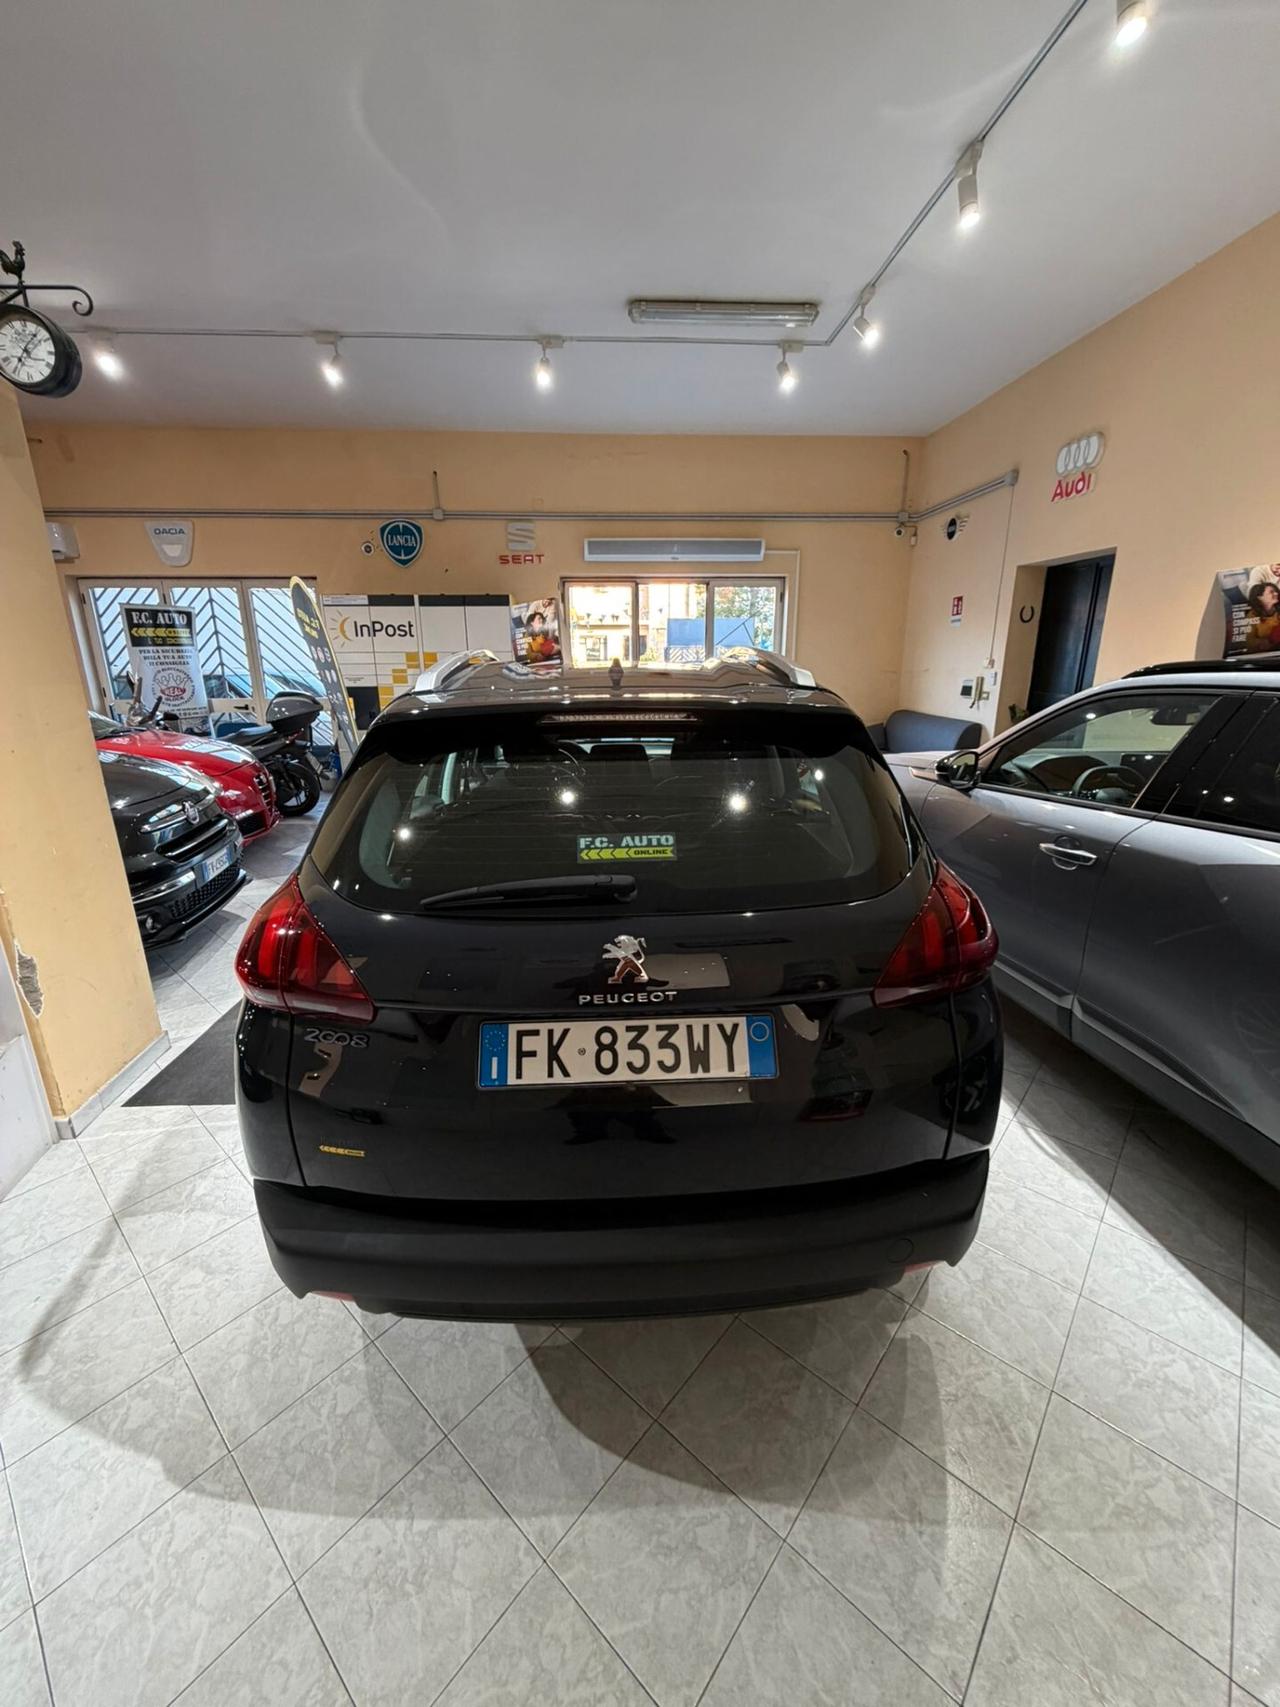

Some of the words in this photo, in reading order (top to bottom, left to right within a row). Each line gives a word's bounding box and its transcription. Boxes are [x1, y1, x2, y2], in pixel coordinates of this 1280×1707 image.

[1051, 471, 1092, 502] Audi
[153, 527, 186, 536] DACIA
[388, 534, 417, 547] LANCIA
[499, 554, 545, 565] SEAT
[131, 611, 153, 624] F.C.
[156, 612, 188, 625] AUTO
[353, 620, 415, 638] InPost
[580, 837, 614, 848] F.C.
[621, 834, 674, 847] AUTO
[634, 848, 669, 856] ONLINE
[578, 991, 678, 1006] PEUGEOT
[303, 1028, 370, 1049] 2008
[515, 1027, 572, 1080] FK
[594, 1022, 740, 1076] 833WY
